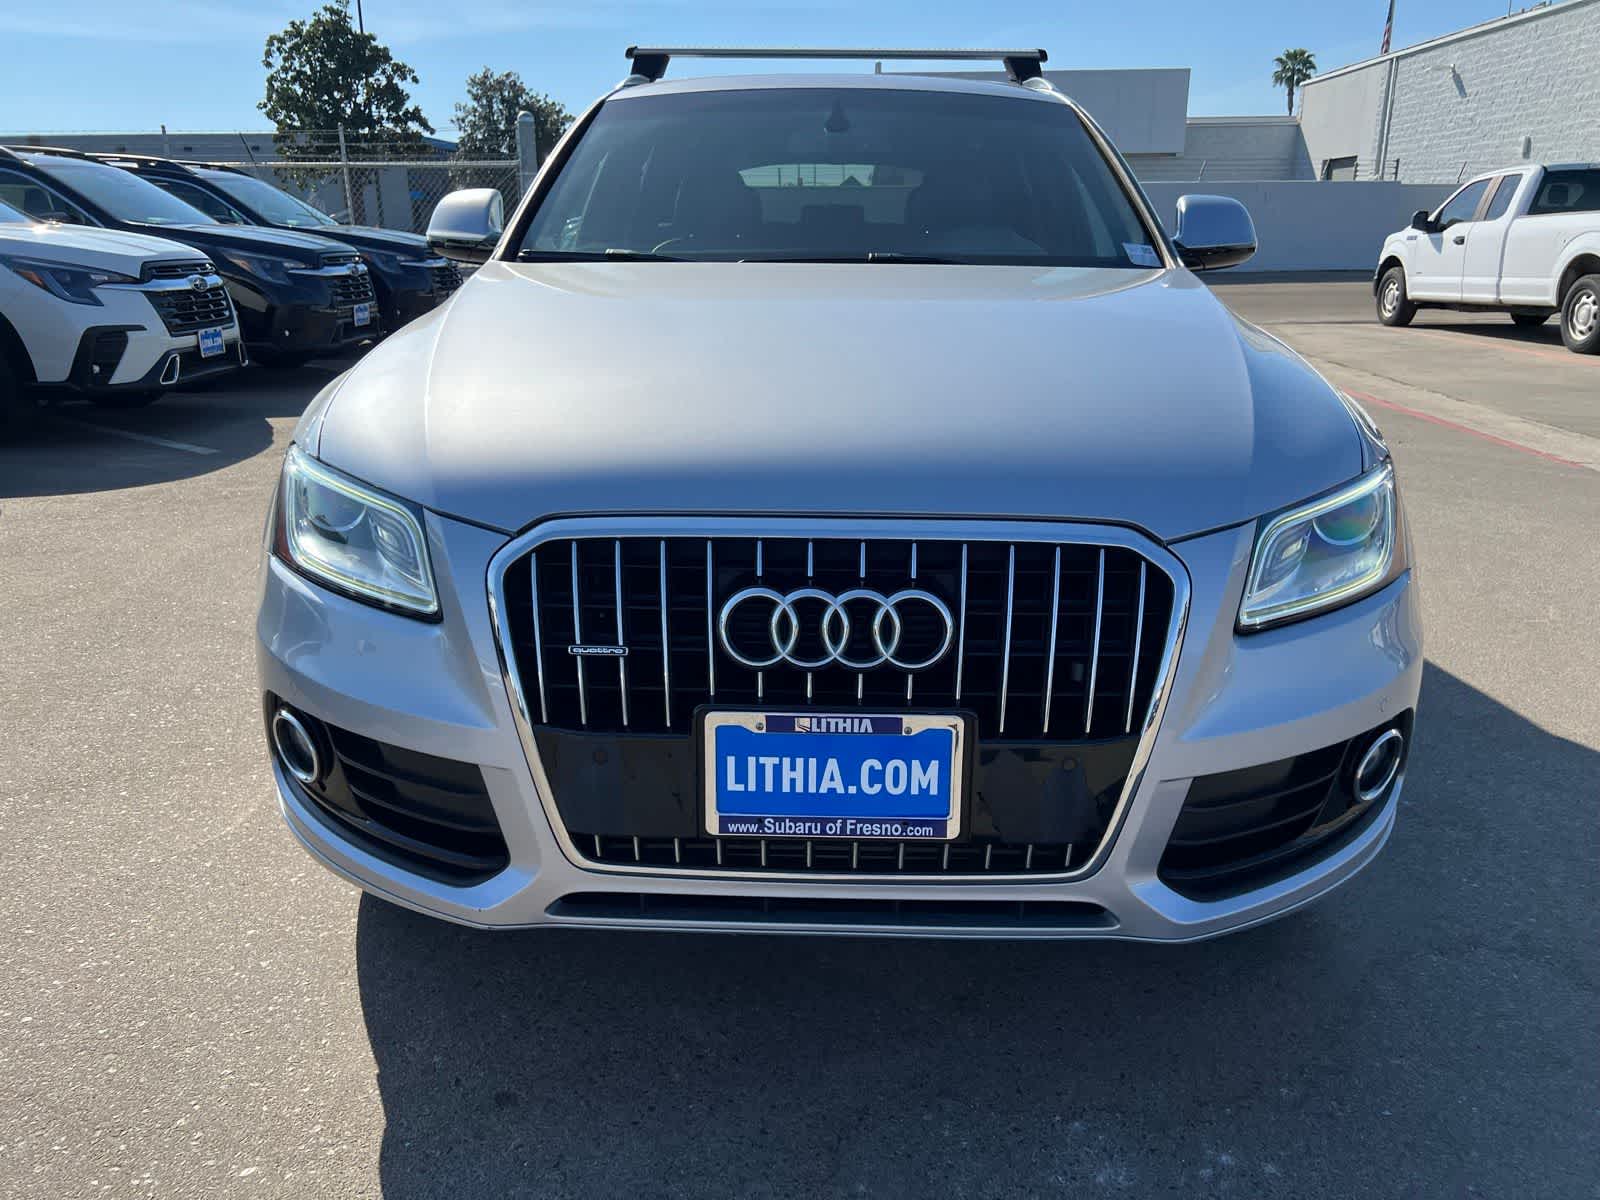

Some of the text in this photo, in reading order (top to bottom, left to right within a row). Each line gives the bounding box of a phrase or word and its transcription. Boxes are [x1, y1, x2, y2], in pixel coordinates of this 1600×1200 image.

[811, 717, 873, 734] LITHIA
[726, 755, 939, 795] LITHIA.COM
[826, 819, 843, 834] of
[847, 819, 934, 837] Fresno.com
